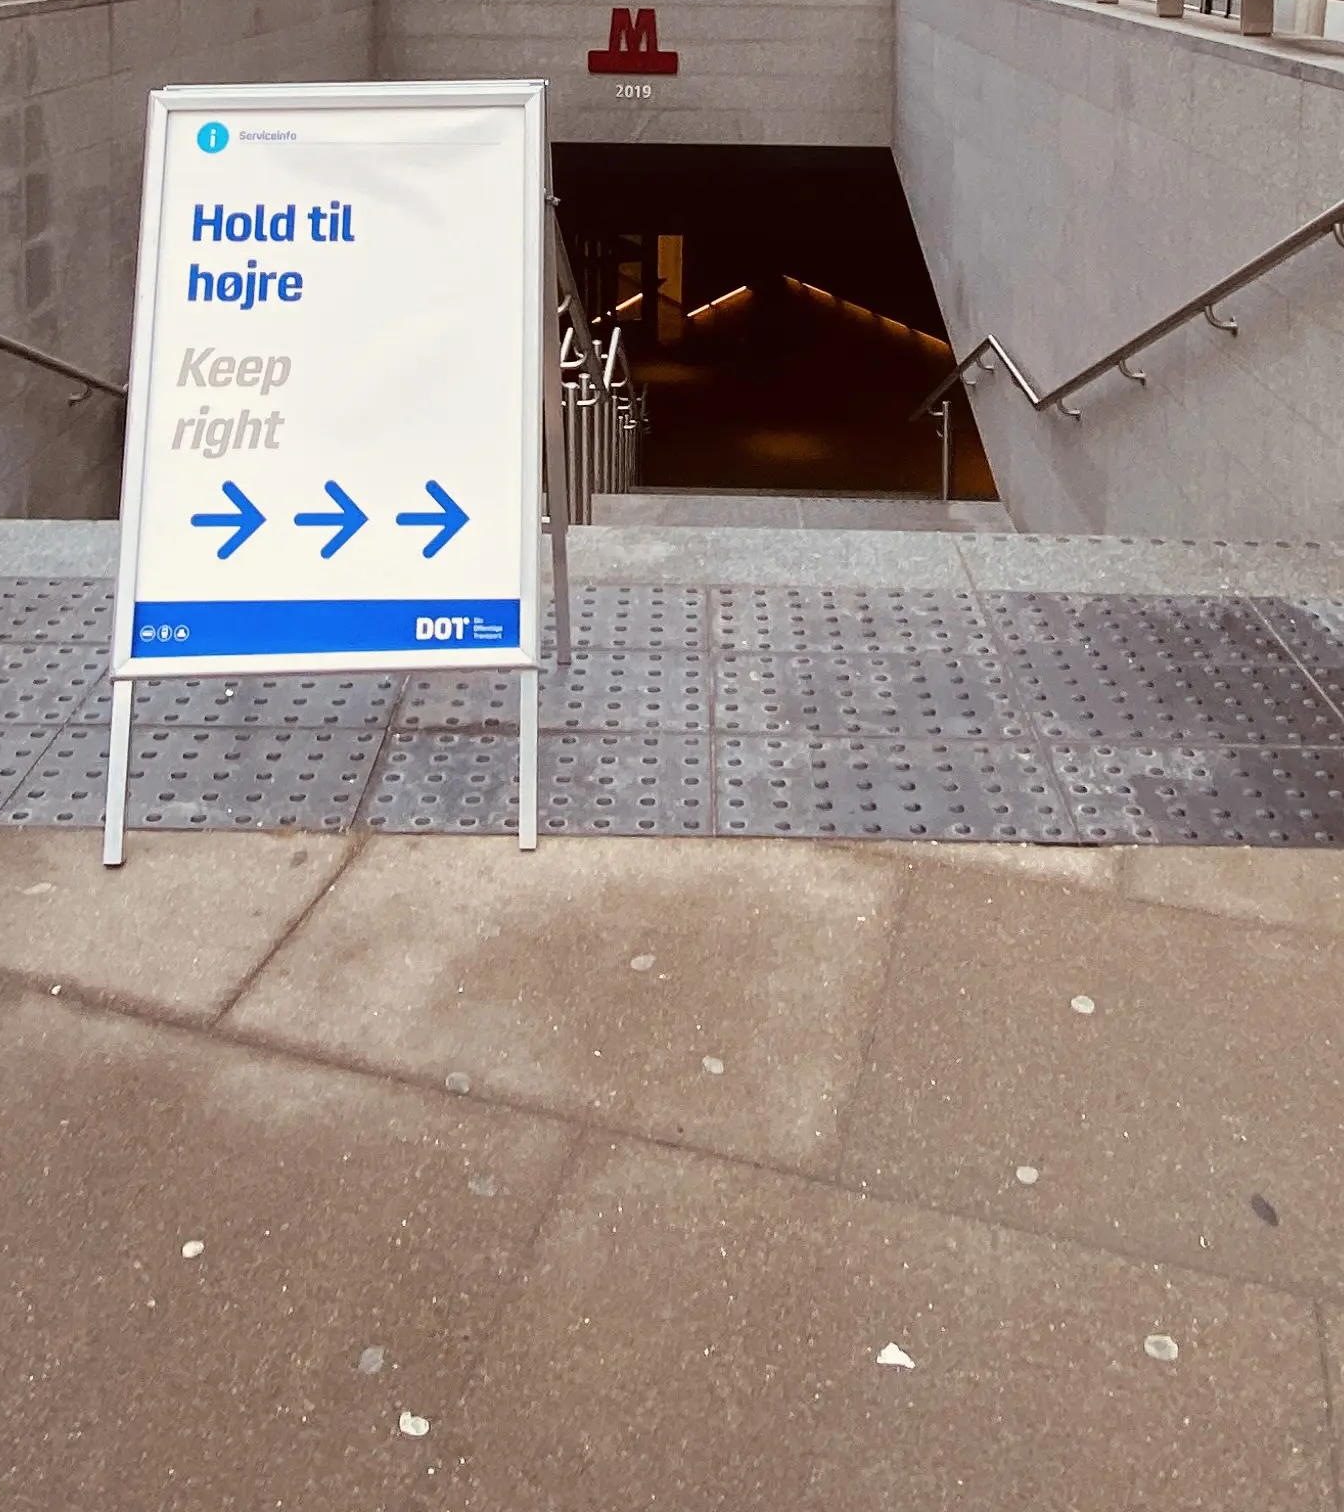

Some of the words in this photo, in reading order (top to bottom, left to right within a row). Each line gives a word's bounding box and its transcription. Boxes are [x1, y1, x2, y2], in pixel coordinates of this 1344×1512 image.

[615, 85, 652, 99] 2019
[239, 130, 297, 140] Serviceinfo
[192, 204, 296, 242] Hold
[308, 200, 355, 242] til
[188, 259, 303, 310] højre
[176, 347, 292, 396] Keep
[171, 405, 285, 459] right
[416, 616, 470, 640] DOT
